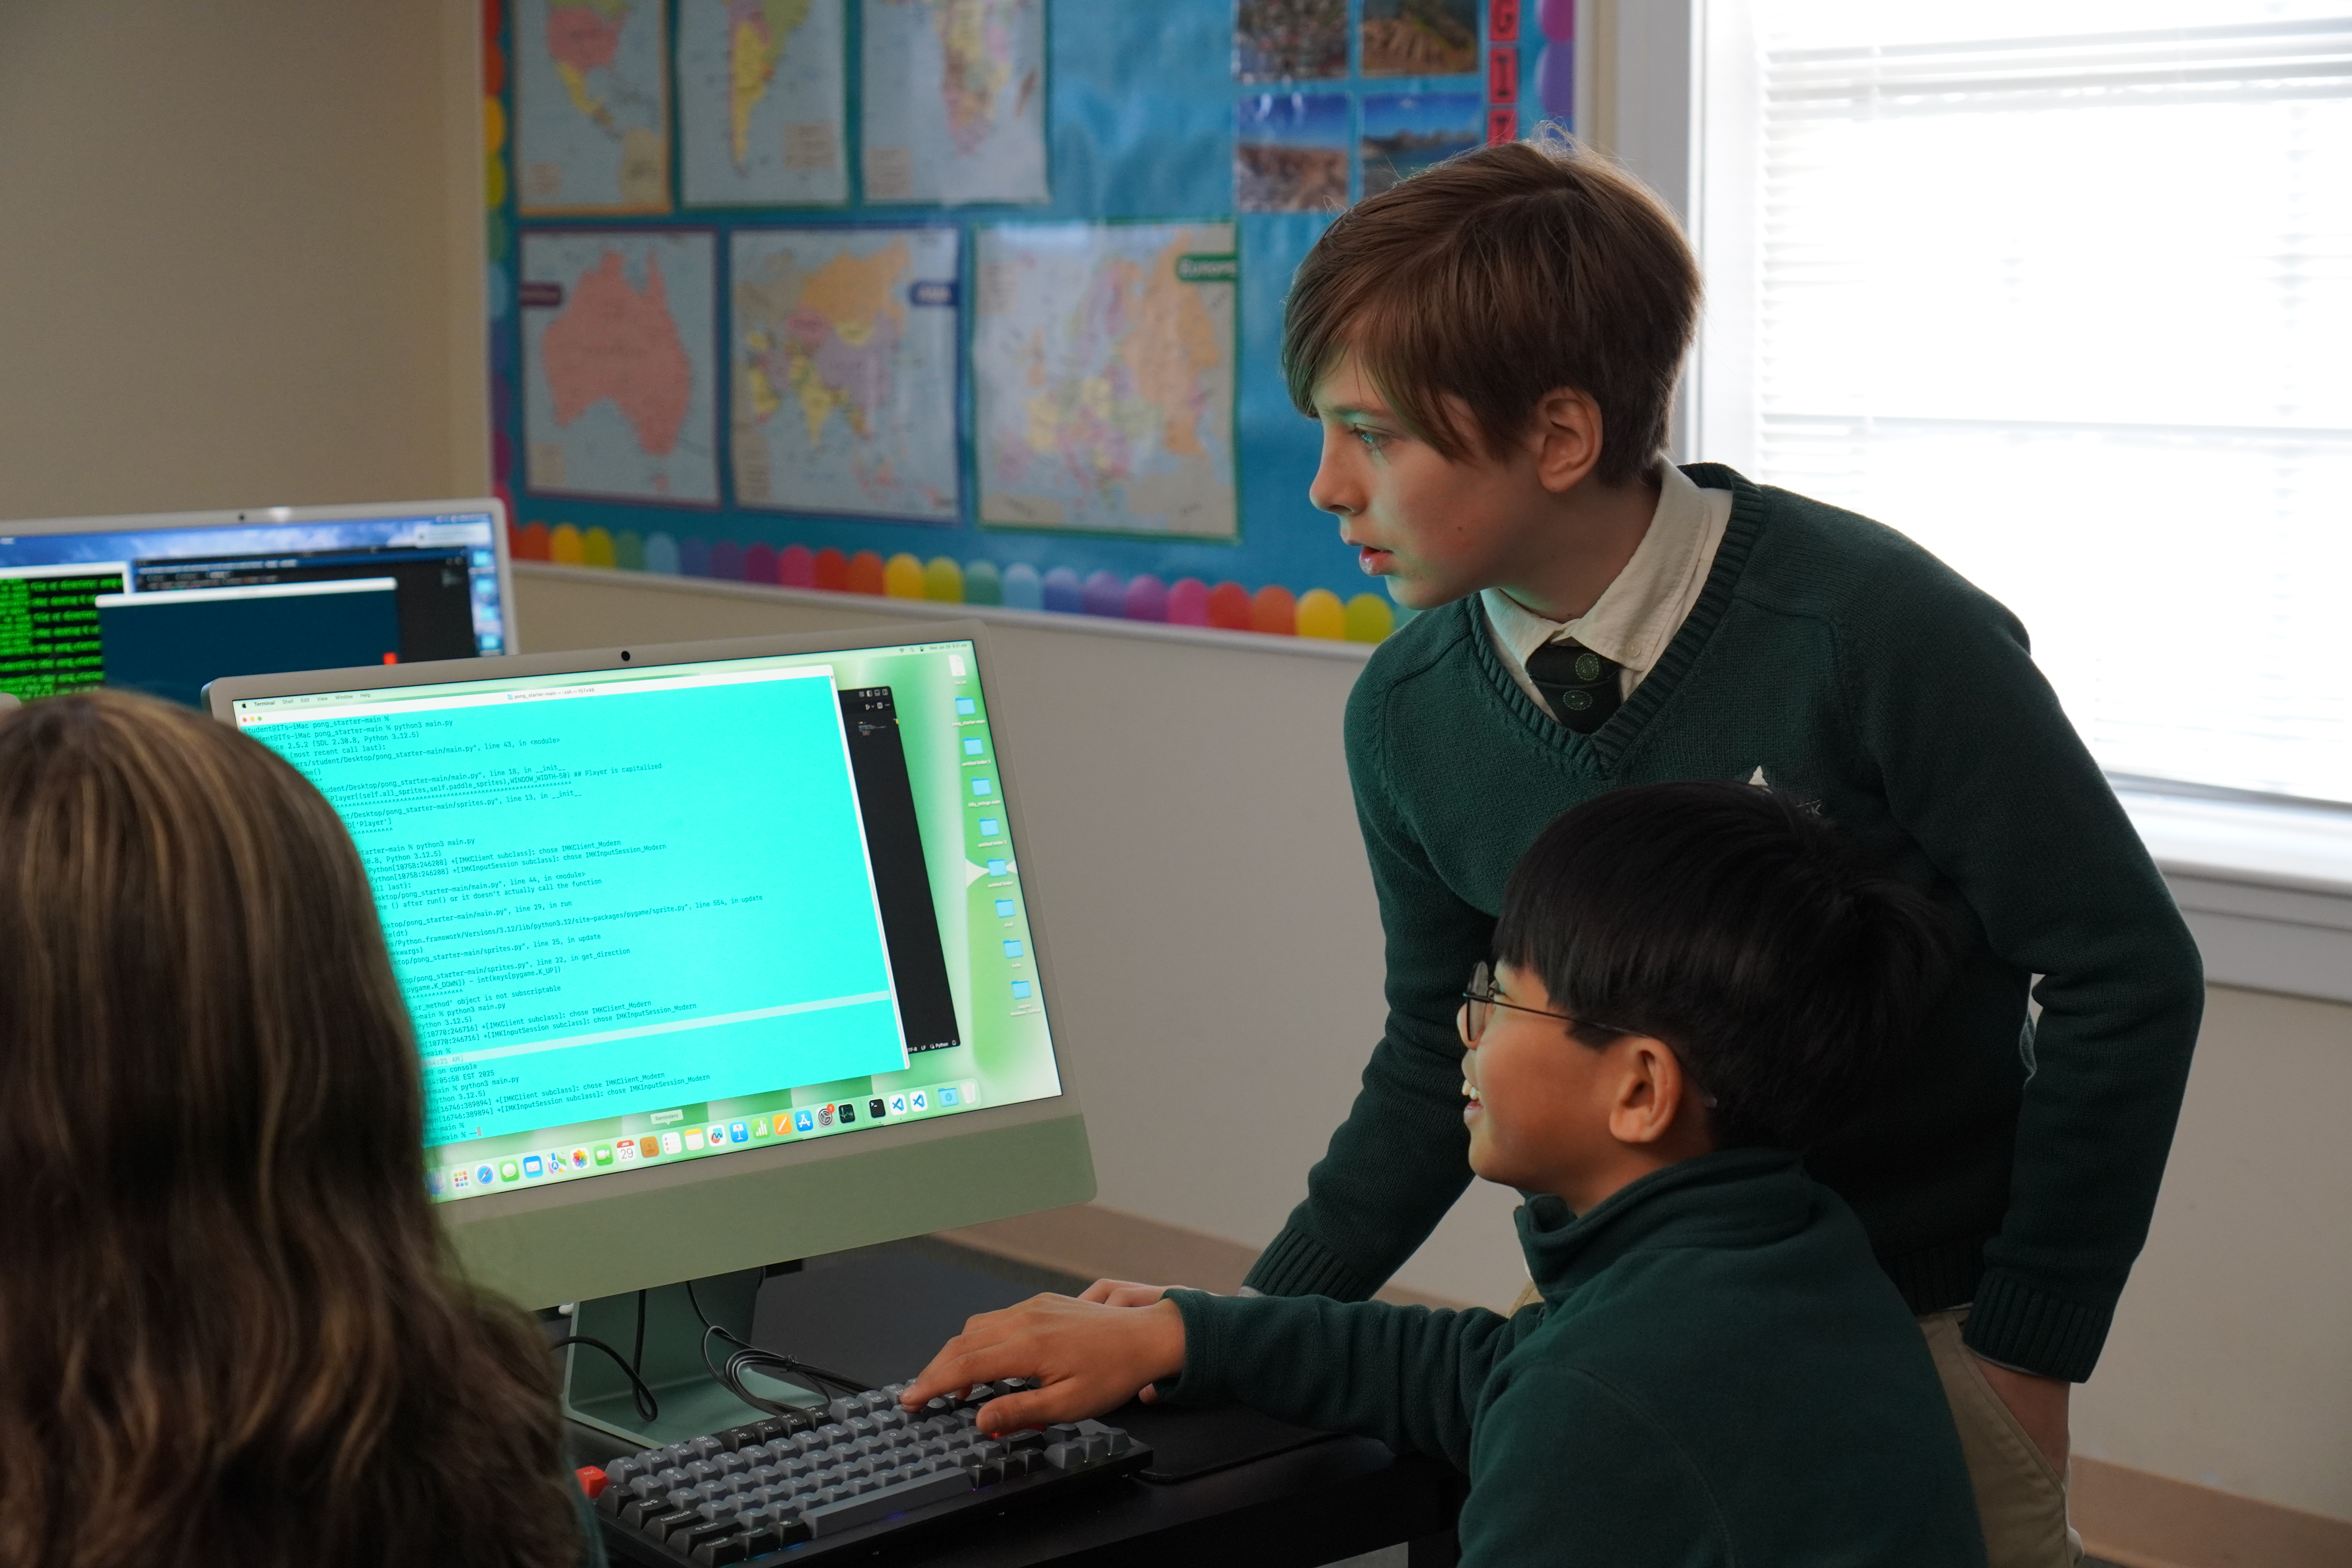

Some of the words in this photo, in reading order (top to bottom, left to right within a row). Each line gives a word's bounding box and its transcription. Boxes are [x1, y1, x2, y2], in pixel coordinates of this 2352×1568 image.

[514, 690, 557, 700] pong_starter-main
[313, 716, 381, 729] pong_starter-main
[315, 725, 383, 738] pong_starter-main
[394, 721, 422, 731] python3
[312, 739, 329, 747] (SDL
[332, 736, 361, 744] 2.30.8,
[364, 734, 389, 743] Python
[392, 730, 420, 739] 3.12.5)
[290, 750, 311, 759] (most
[314, 747, 339, 755] recent
[362, 743, 387, 751] last):
[535, 764, 566, 773] __init__
[621, 763, 661, 773] capitalized
[552, 790, 582, 799] __init__
[416, 840, 445, 850] python3
[386, 854, 411, 862] Python
[414, 849, 442, 858] 3.12.5)
[451, 853, 494, 864] +[IMKClient
[497, 849, 535, 859] subclass]:
[561, 840, 621, 852] IMKClient_Modern
[453, 860, 519, 873] +[IMKInputSession
[521, 855, 559, 865] subclass]:
[555, 871, 586, 880] <module>
[388, 881, 412, 889] last):
[426, 895, 446, 904] run()
[473, 889, 501, 898] doesn't
[504, 886, 535, 895] actually
[571, 879, 602, 887] function
[741, 895, 762, 904] update
[578, 933, 601, 943] update
[582, 949, 630, 961] get_direction
[457, 995, 481, 1005] object
[511, 985, 561, 997] subscriptable
[447, 1005, 475, 1017] python3
[482, 1018, 525, 1030] +[IMKClient
[528, 1012, 566, 1023] subclass]:
[592, 1001, 652, 1014] IMKClient_Modern
[417, 1021, 442, 1030] Python
[445, 1015, 473, 1025] 3.12.5)
[483, 1025, 549, 1039] +[IMKInputSession
[552, 1018, 590, 1029] subclass]:
[450, 1063, 478, 1072] console
[478, 1069, 495, 1078] 2025
[461, 1080, 489, 1091] python3
[492, 1077, 520, 1085] main.py
[495, 1091, 539, 1104] +[IMKClient
[542, 1085, 580, 1096] subclass]:
[605, 1073, 665, 1087] IMKClient_Modern
[458, 1089, 486, 1100] 3.12.5)
[497, 1098, 563, 1113] +[IMKInputSession
[566, 1091, 604, 1102] subclass]:
[655, 1113, 679, 1121] Reminders
[620, 1148, 633, 1160] 29
